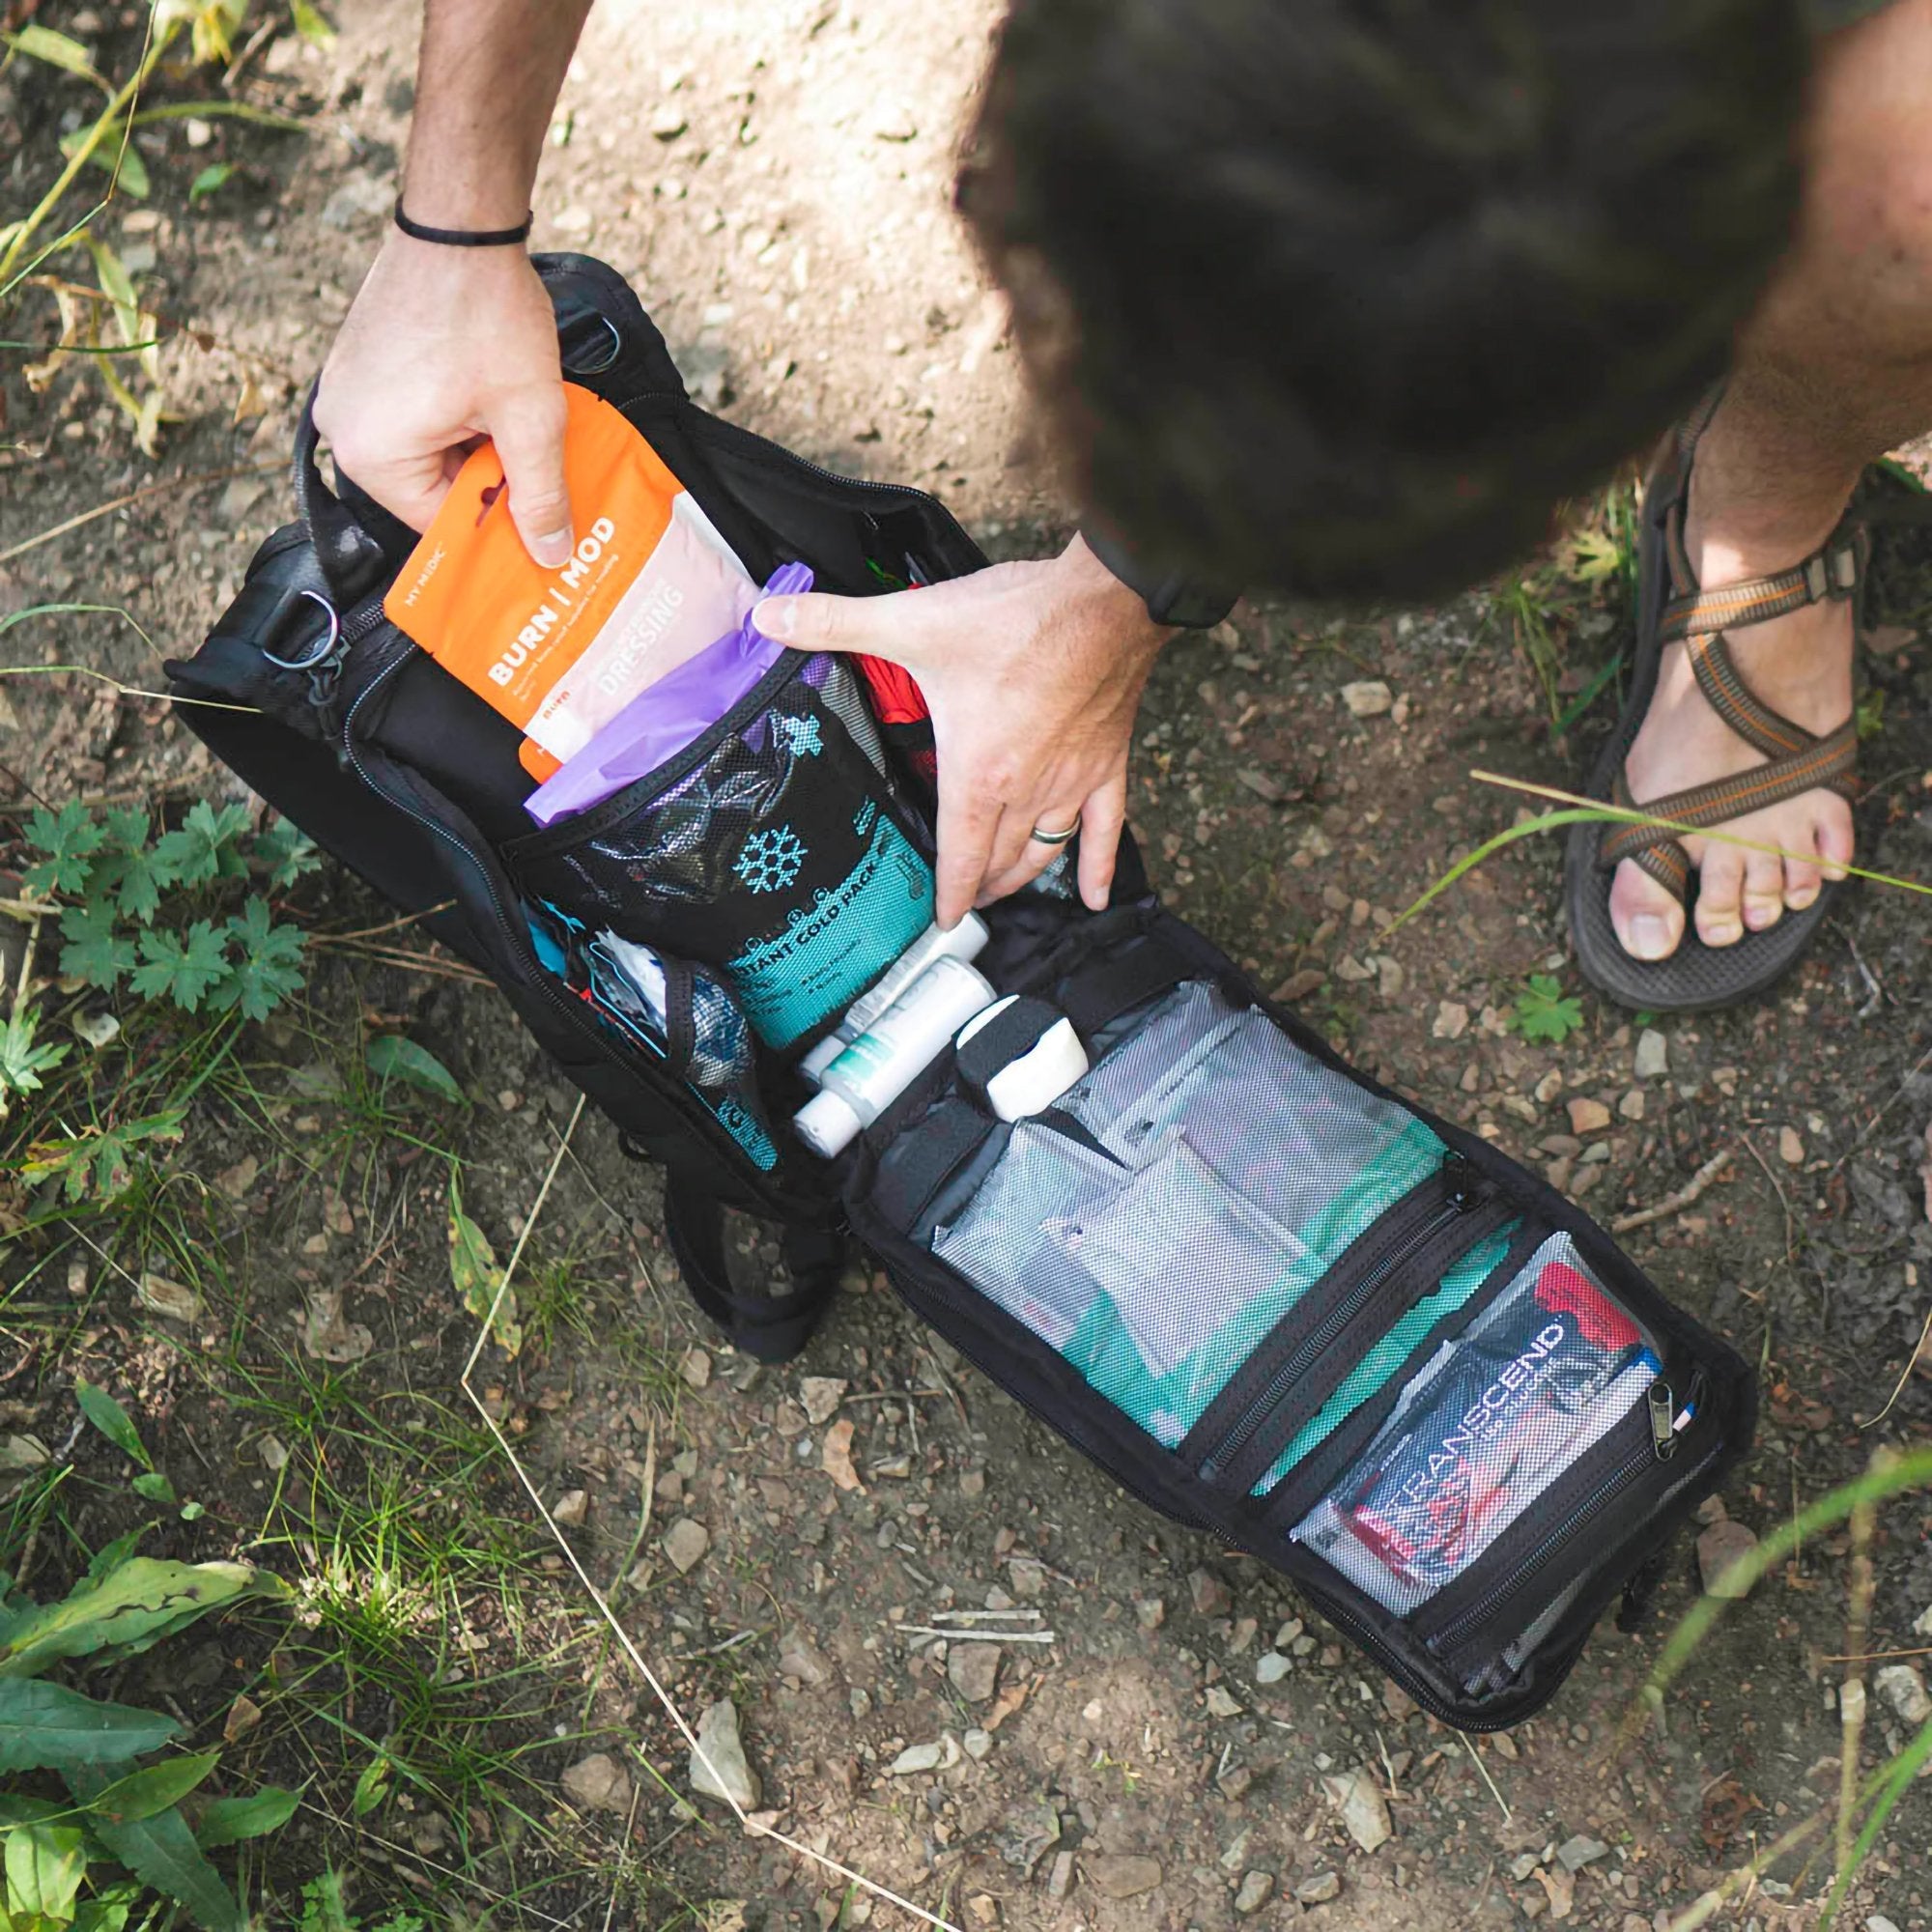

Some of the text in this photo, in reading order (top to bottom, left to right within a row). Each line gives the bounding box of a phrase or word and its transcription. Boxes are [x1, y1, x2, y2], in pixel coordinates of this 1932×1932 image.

[487, 604, 559, 688] BURN
[559, 517, 615, 589] MOD
[598, 584, 685, 696] DRESSING
[734, 942, 794, 977] TANT
[794, 904, 840, 945] COLD
[839, 860, 876, 907] PACK
[1385, 1322, 1565, 1509] TRANSCEND
